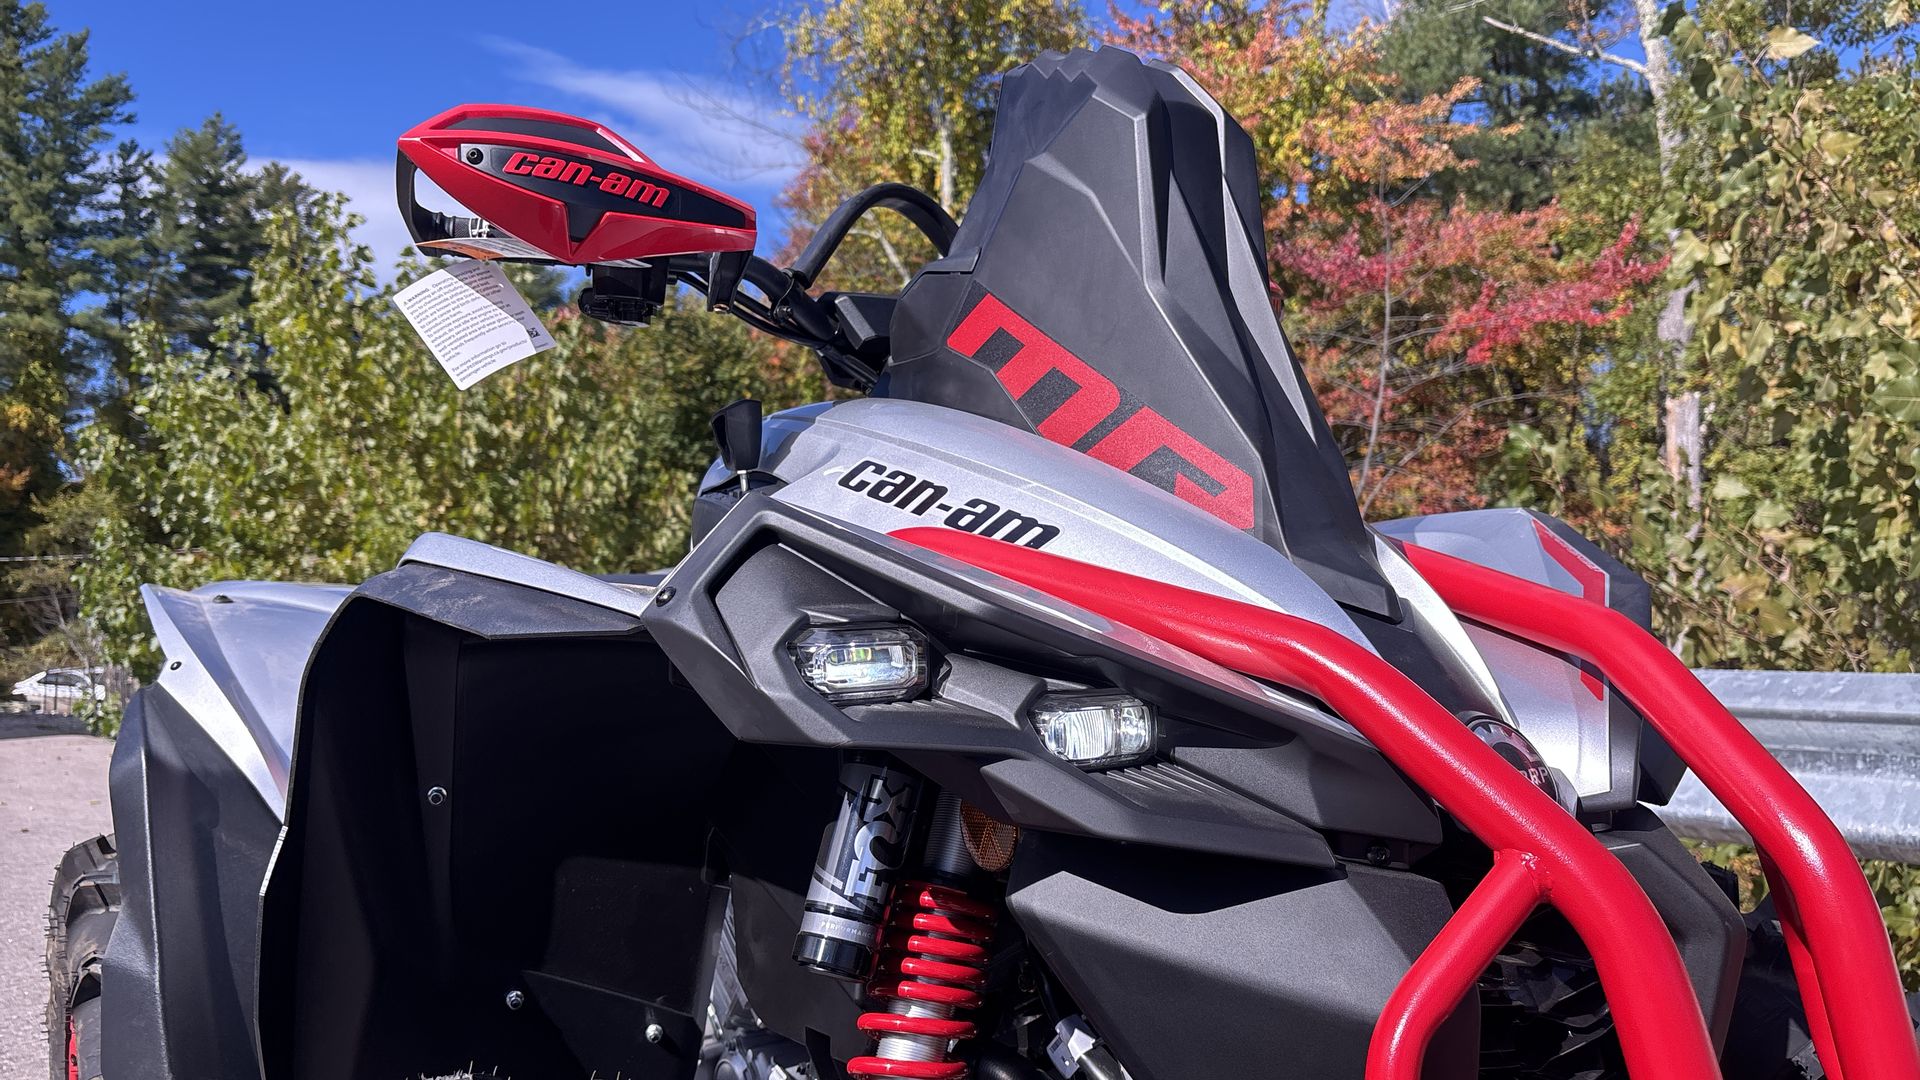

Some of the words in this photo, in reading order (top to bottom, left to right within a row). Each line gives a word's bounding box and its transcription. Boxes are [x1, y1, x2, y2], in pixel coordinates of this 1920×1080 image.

[504, 152, 670, 207] can-am
[837, 459, 1061, 551] can-am
[844, 773, 914, 905] FOX
